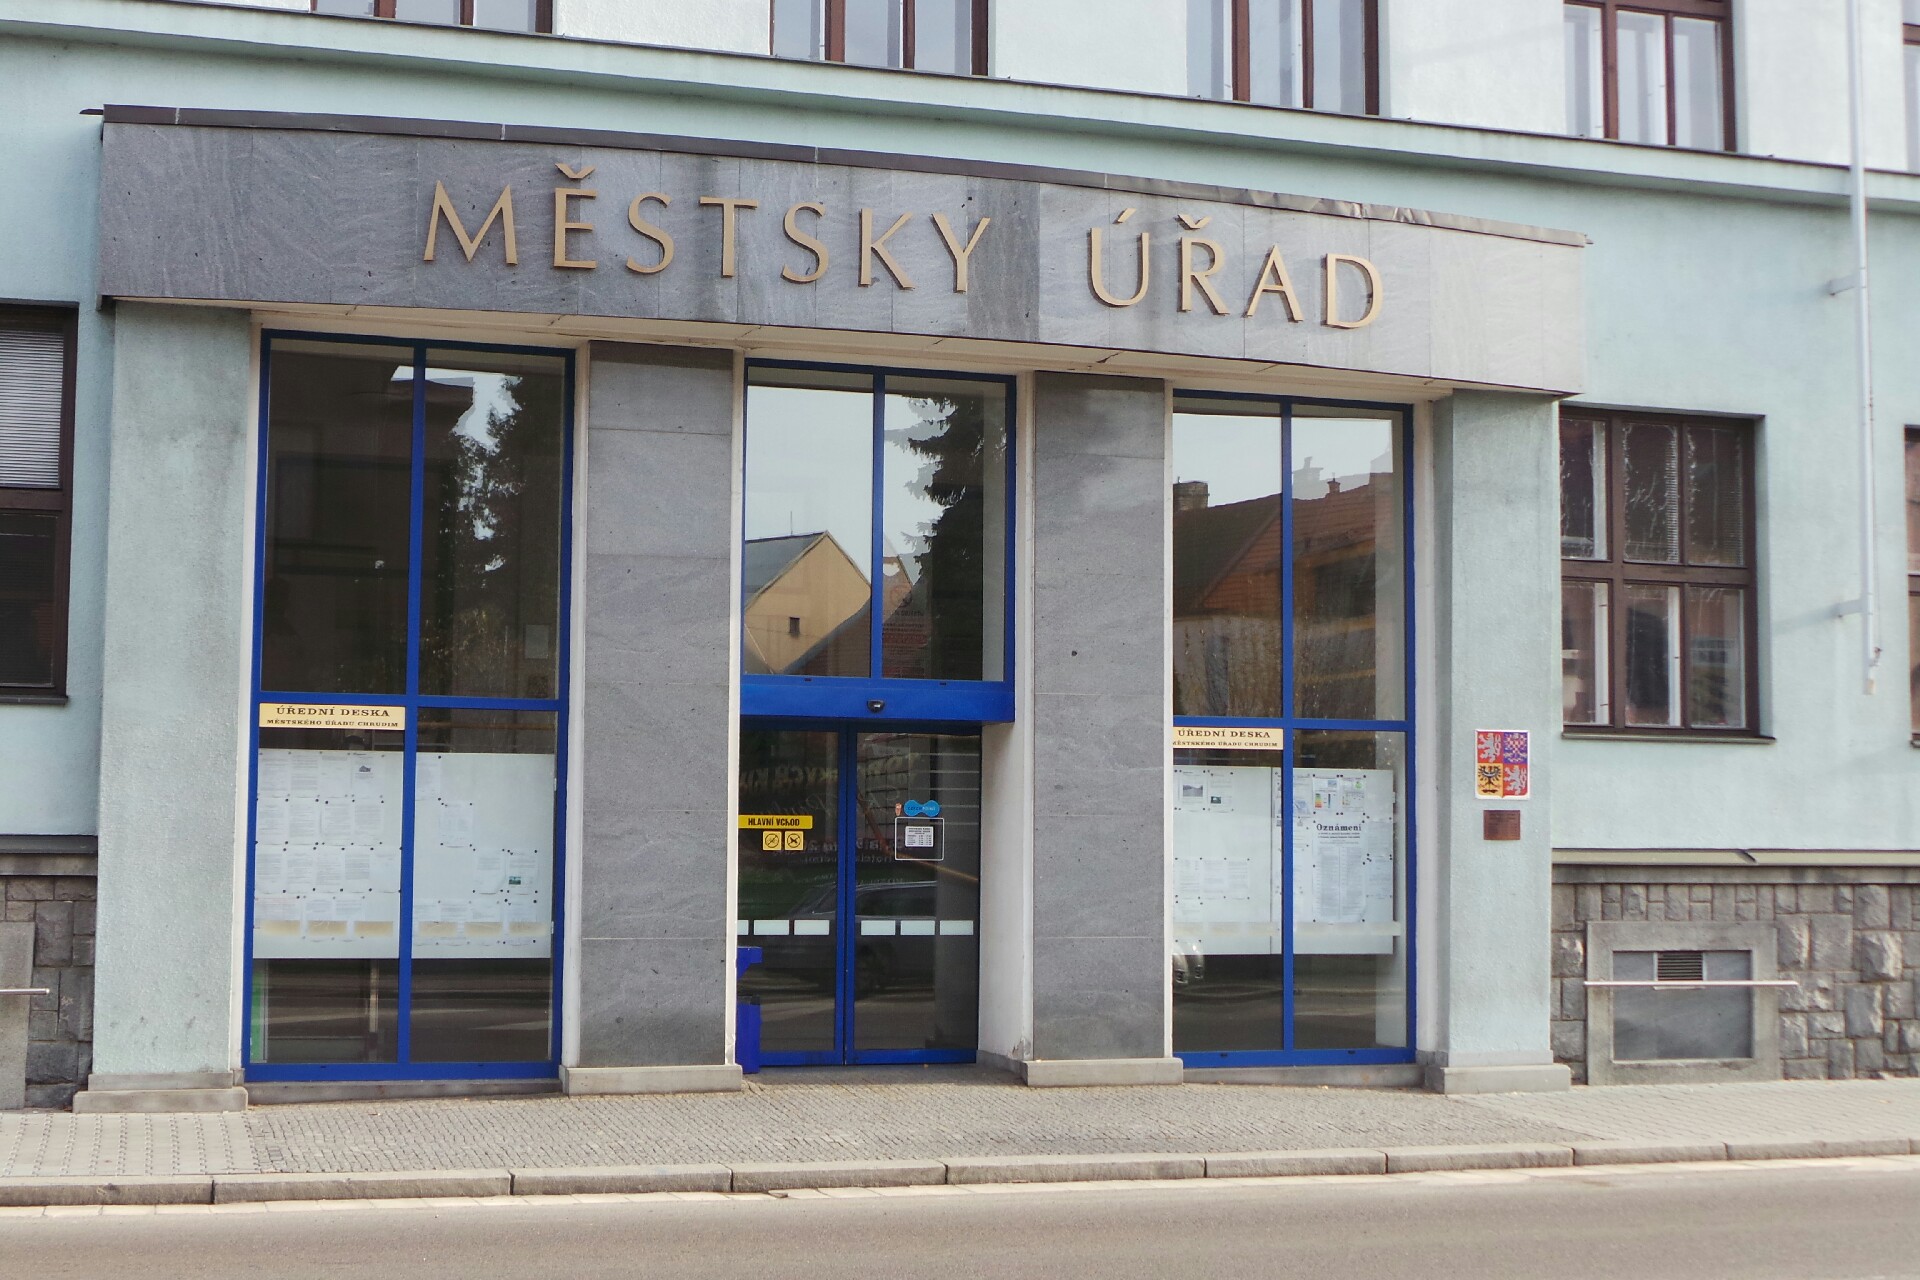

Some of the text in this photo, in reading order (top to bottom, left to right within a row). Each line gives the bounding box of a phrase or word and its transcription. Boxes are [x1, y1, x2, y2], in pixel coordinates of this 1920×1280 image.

[1088, 208, 1383, 329] ÚŘAD
[276, 705, 390, 717] ÚŘEDNÍ DESKA
[266, 718, 322, 726] MĚSTSKÉHO
[1178, 728, 1271, 738] ÚŘEDNÍ DESKA
[748, 816, 774, 826] HLAVNÍ
